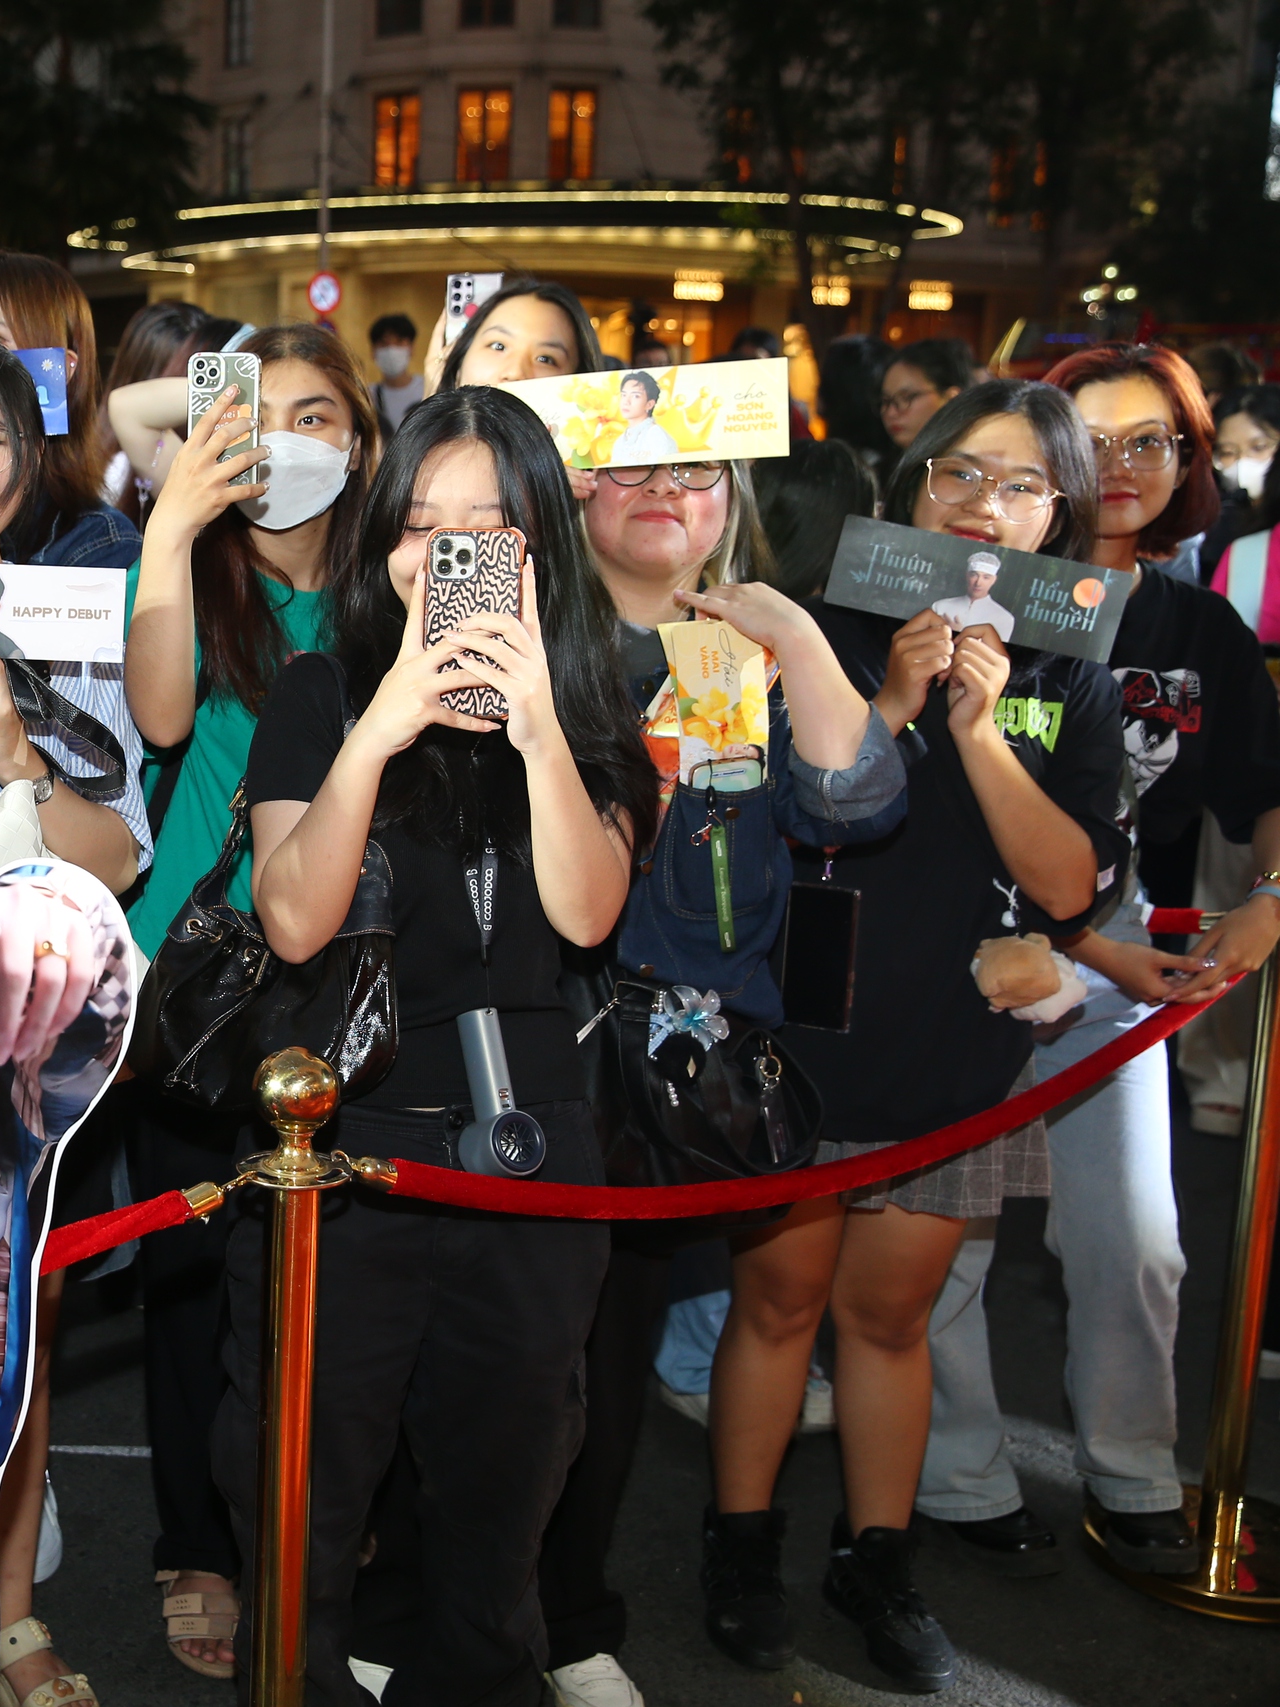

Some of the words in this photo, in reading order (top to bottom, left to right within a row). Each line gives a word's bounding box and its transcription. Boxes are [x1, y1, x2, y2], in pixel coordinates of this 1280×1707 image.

[733, 382, 768, 400] cho
[12, 606, 62, 619] HAPPY
[67, 608, 112, 620] DEBUT
[700, 645, 710, 679] VÀNG
[711, 650, 720, 673] MAI
